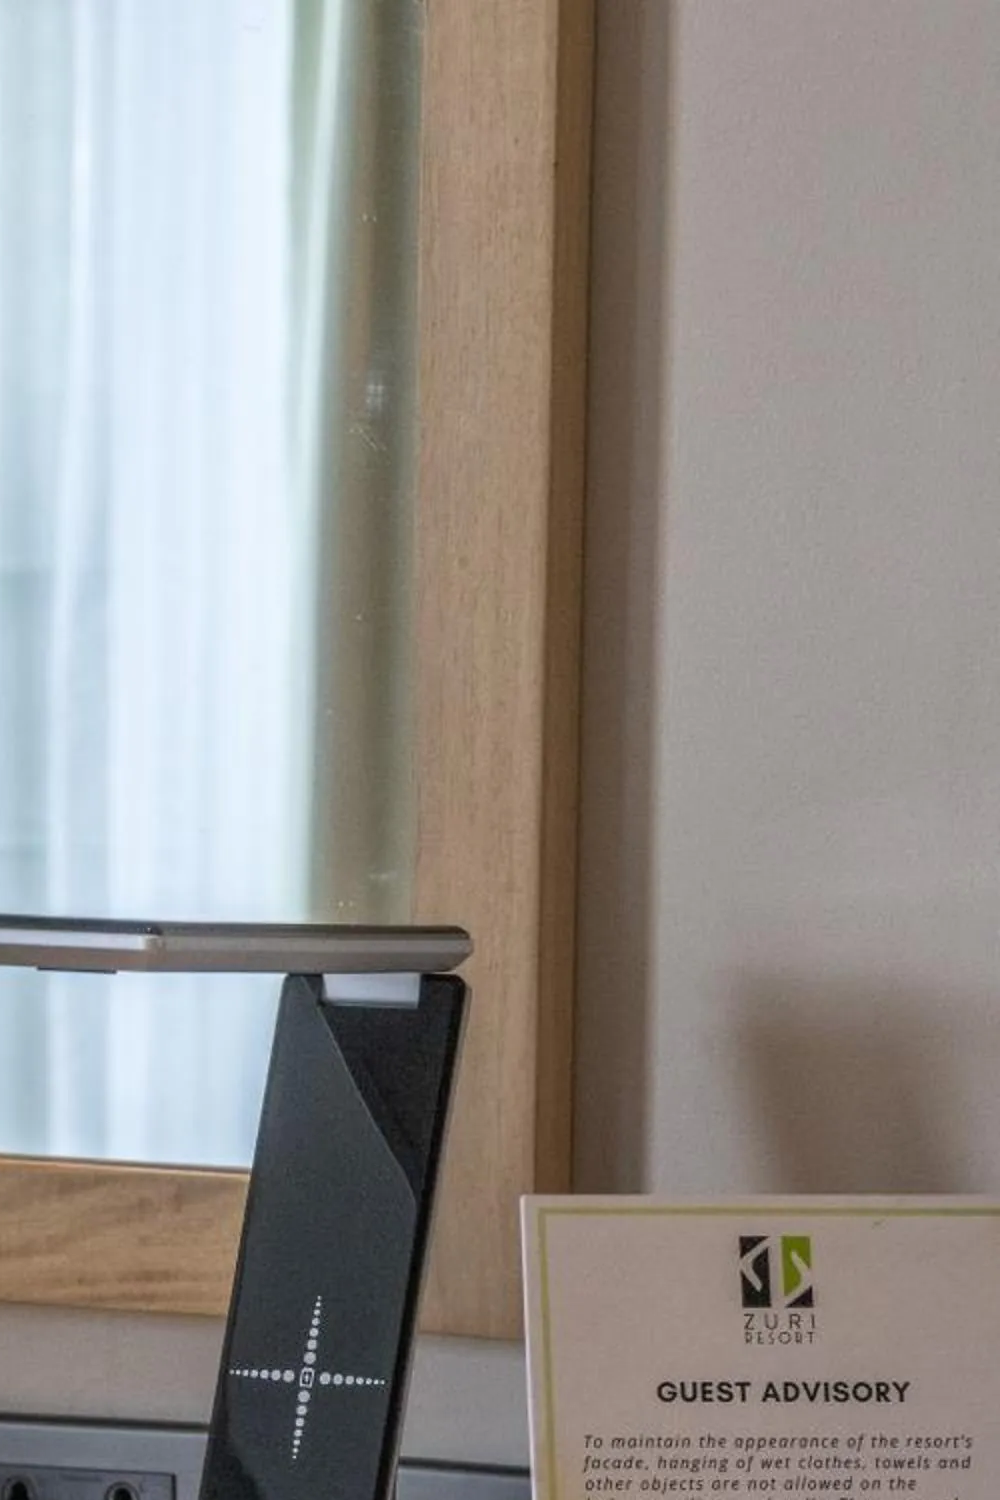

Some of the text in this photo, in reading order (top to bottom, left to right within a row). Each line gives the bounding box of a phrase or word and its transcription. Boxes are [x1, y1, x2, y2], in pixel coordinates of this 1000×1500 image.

[743, 1312, 817, 1330] ZURI
[743, 1331, 817, 1346] RESORT
[655, 1378, 912, 1406] GUEST ADVISORY
[583, 1432, 973, 1453] To maintain the appearance of the resort's
[581, 1454, 972, 1474] facade, hanging of wet clothes, towels and
[584, 1474, 917, 1495] other objects are not allowed on the
